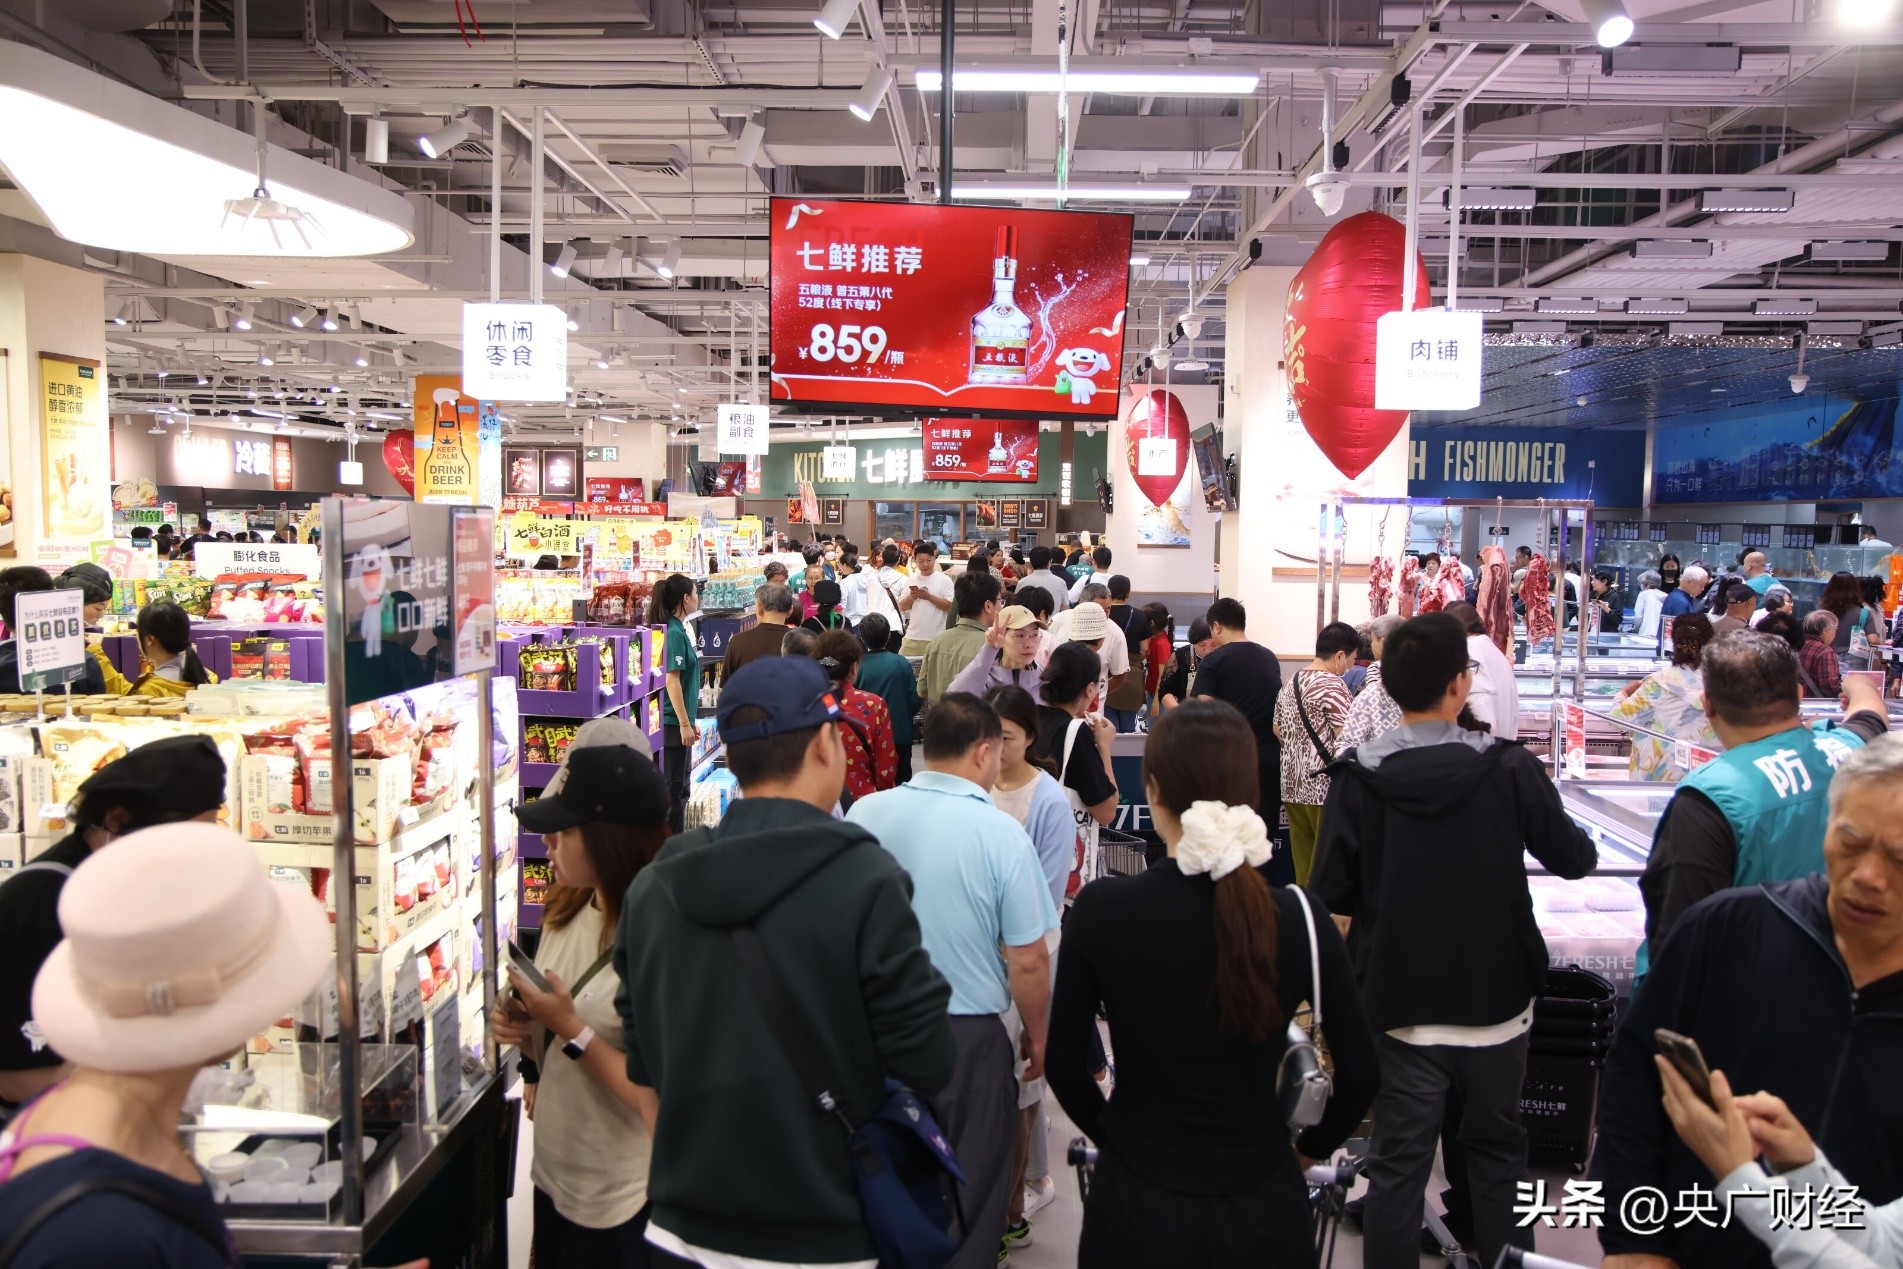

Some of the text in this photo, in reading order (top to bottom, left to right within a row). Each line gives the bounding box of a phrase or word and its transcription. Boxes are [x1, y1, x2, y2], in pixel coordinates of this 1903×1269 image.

[796, 241, 923, 275] 七鲜推荐
[798, 283, 893, 300] 五粮液 普五第八代
[798, 296, 882, 312] 52度(线下专享)
[486, 319, 533, 343] 休闲
[486, 344, 533, 367] 零食
[1410, 338, 1459, 362] 肉铺
[48, 380, 83, 399] 进口黄油
[729, 412, 755, 425] 粮油
[729, 426, 755, 439] 副食
[931, 428, 972, 439] 七鲜推荐
[429, 465, 465, 474] DRINK
[794, 452, 856, 484] KITC
[1443, 440, 1566, 484] FISHMONGER
[432, 475, 463, 485] BEER
[499, 496, 541, 511] 糖葫芦
[514, 523, 571, 539] 七鲜白酒
[233, 550, 281, 563] 膨化食品
[396, 555, 448, 591] 七鲜七鲜
[292, 825, 332, 836] 厚切苹果
